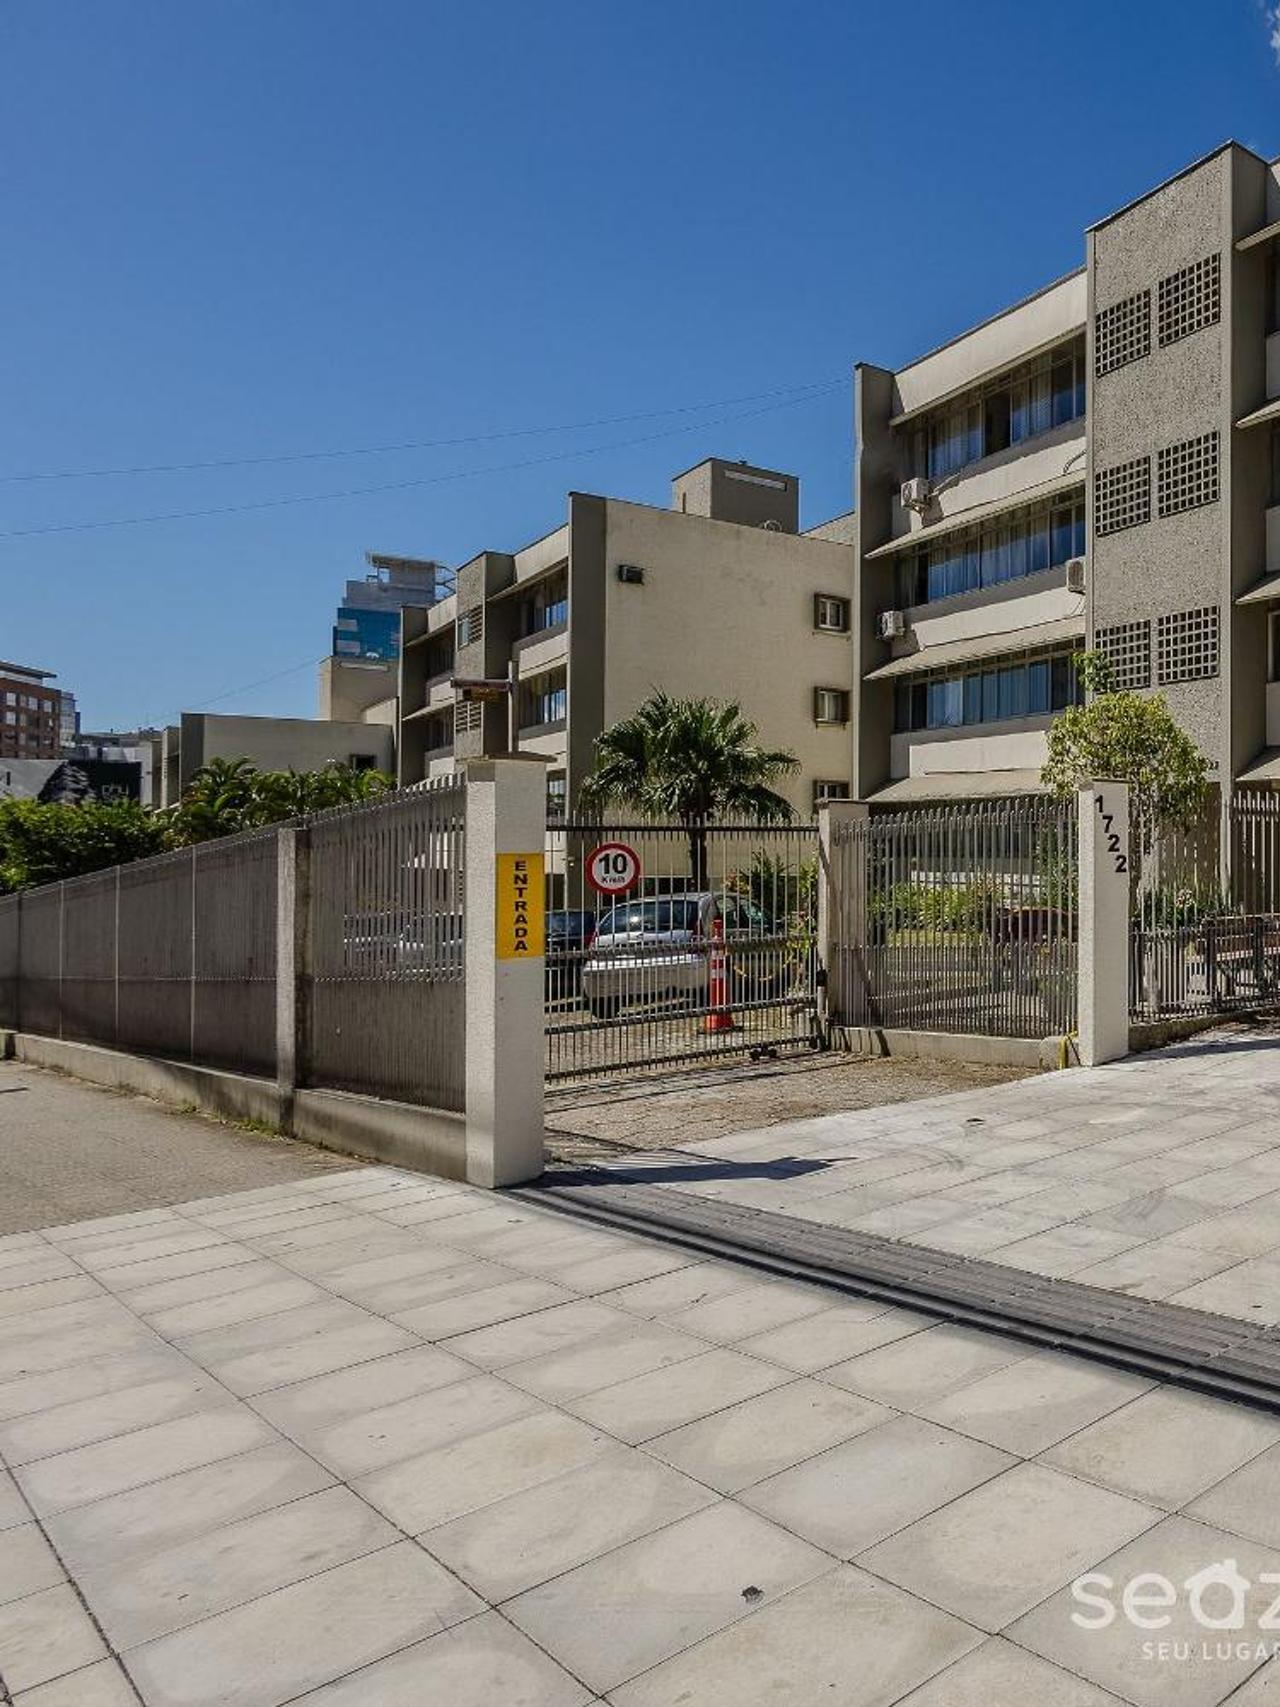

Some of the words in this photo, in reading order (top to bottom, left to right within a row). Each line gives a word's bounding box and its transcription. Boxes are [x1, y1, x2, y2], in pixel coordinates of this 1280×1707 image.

[598, 853, 628, 875] 10
[1094, 794, 1127, 873] 1722
[513, 860, 528, 951] ENTRADA
